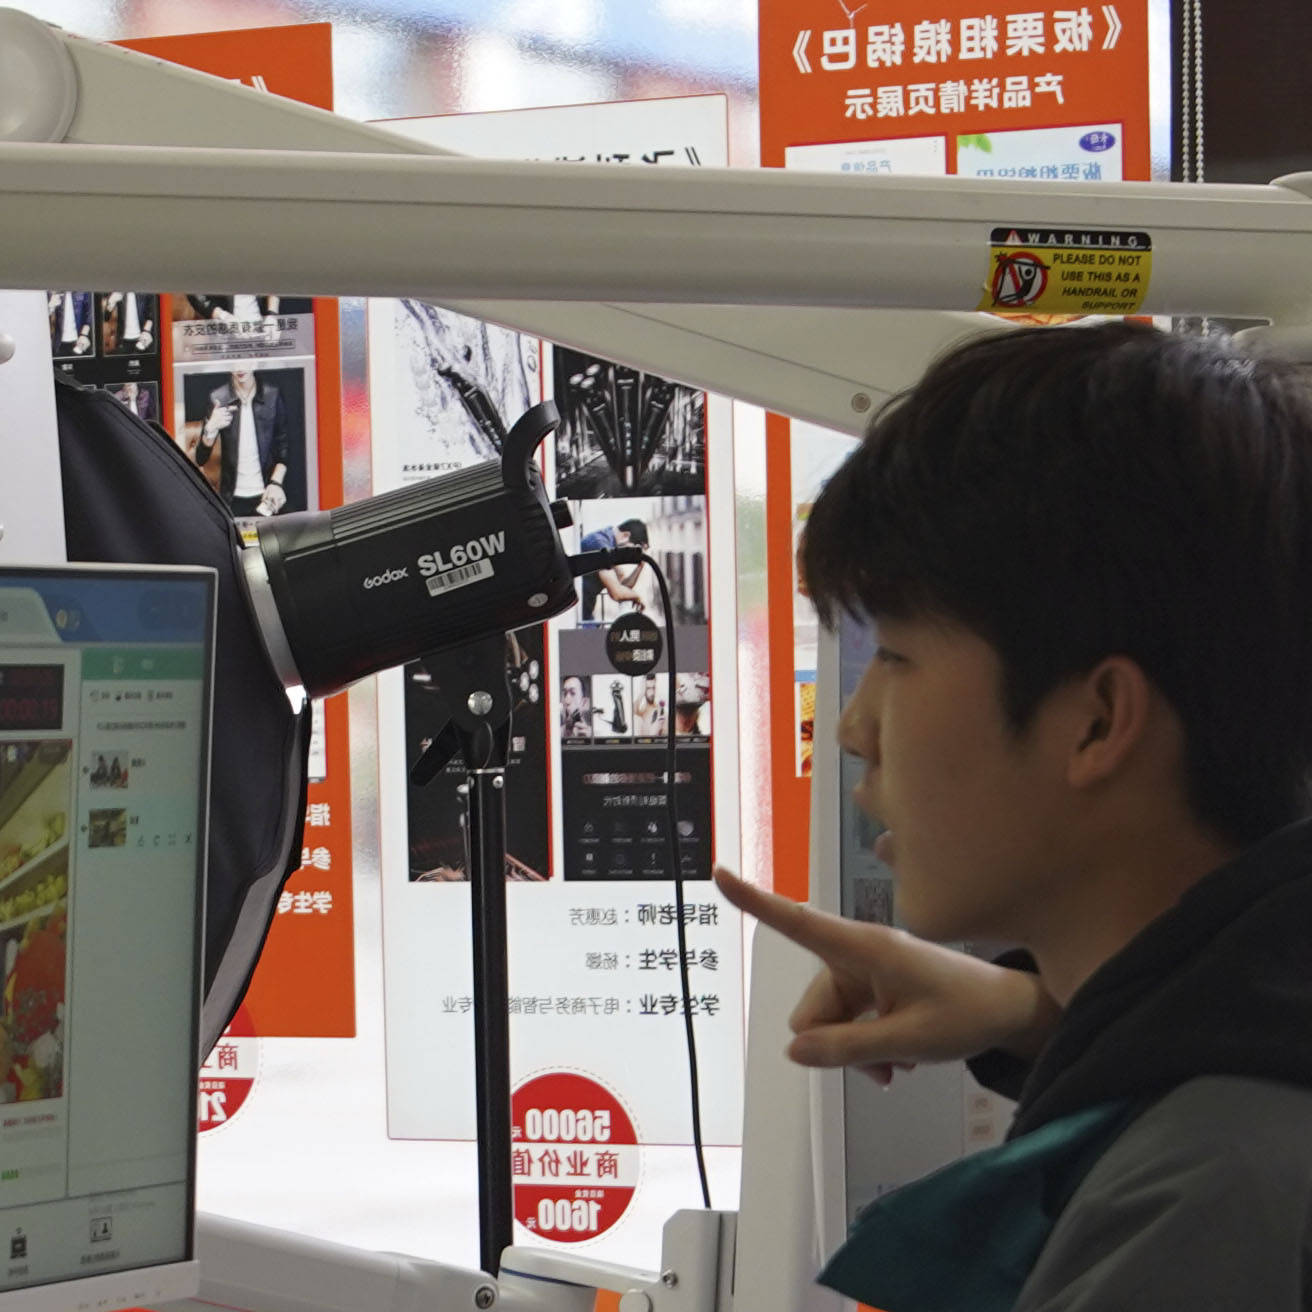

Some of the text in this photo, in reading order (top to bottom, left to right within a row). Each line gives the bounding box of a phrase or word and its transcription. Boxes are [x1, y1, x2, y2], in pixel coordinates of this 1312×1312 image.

[1028, 232, 1138, 248] WARNING
[1053, 253, 1141, 266] PLEASE DO NOT
[1061, 271, 1140, 282] USE THIS AS A
[1061, 287, 1138, 298] HANDRAIL OR
[1082, 301, 1135, 310] SUPPORT
[363, 530, 507, 590] Godox SL60W
